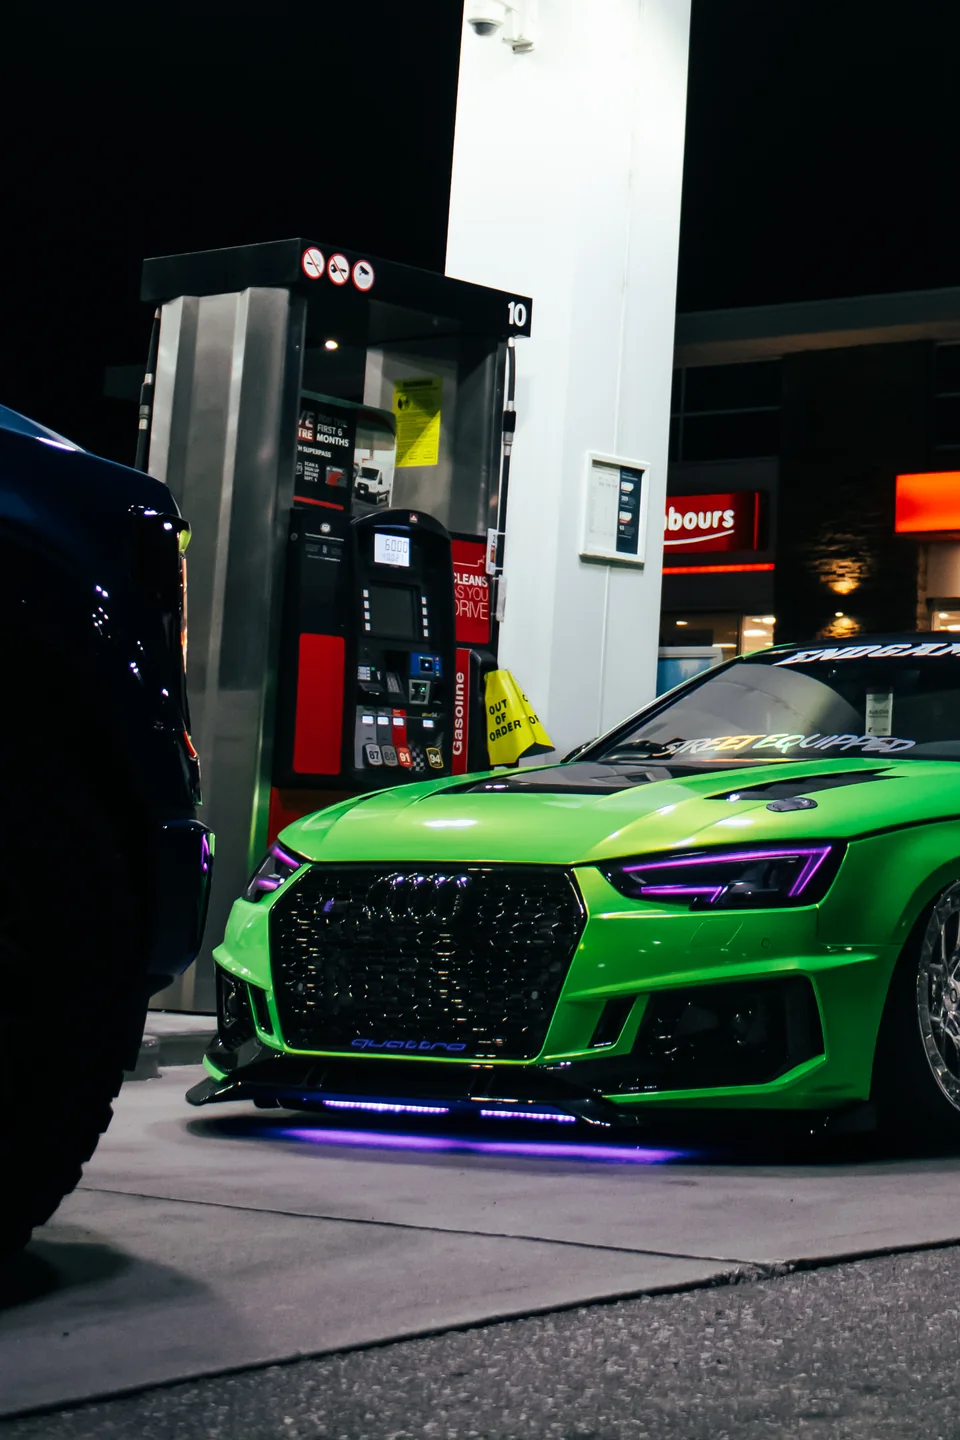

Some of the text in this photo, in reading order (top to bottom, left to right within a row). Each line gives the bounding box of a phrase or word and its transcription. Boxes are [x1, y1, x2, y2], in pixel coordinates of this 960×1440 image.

[508, 301, 527, 327] 10
[298, 427, 313, 439] TRE
[317, 424, 343, 436] FIRST 6
[316, 433, 349, 447] MONTHS
[303, 446, 331, 457] SUPERPASS
[467, 587, 489, 601] YOU
[453, 672, 464, 755] Gasoline
[489, 699, 507, 715] OUT
[495, 712, 506, 725] OF
[490, 720, 521, 741] ORDER
[653, 734, 916, 757] STREET EQUIPPED
[369, 751, 379, 759] 87
[400, 753, 410, 762] 91
[430, 753, 441, 762] 94
[351, 1038, 467, 1051] quattro
